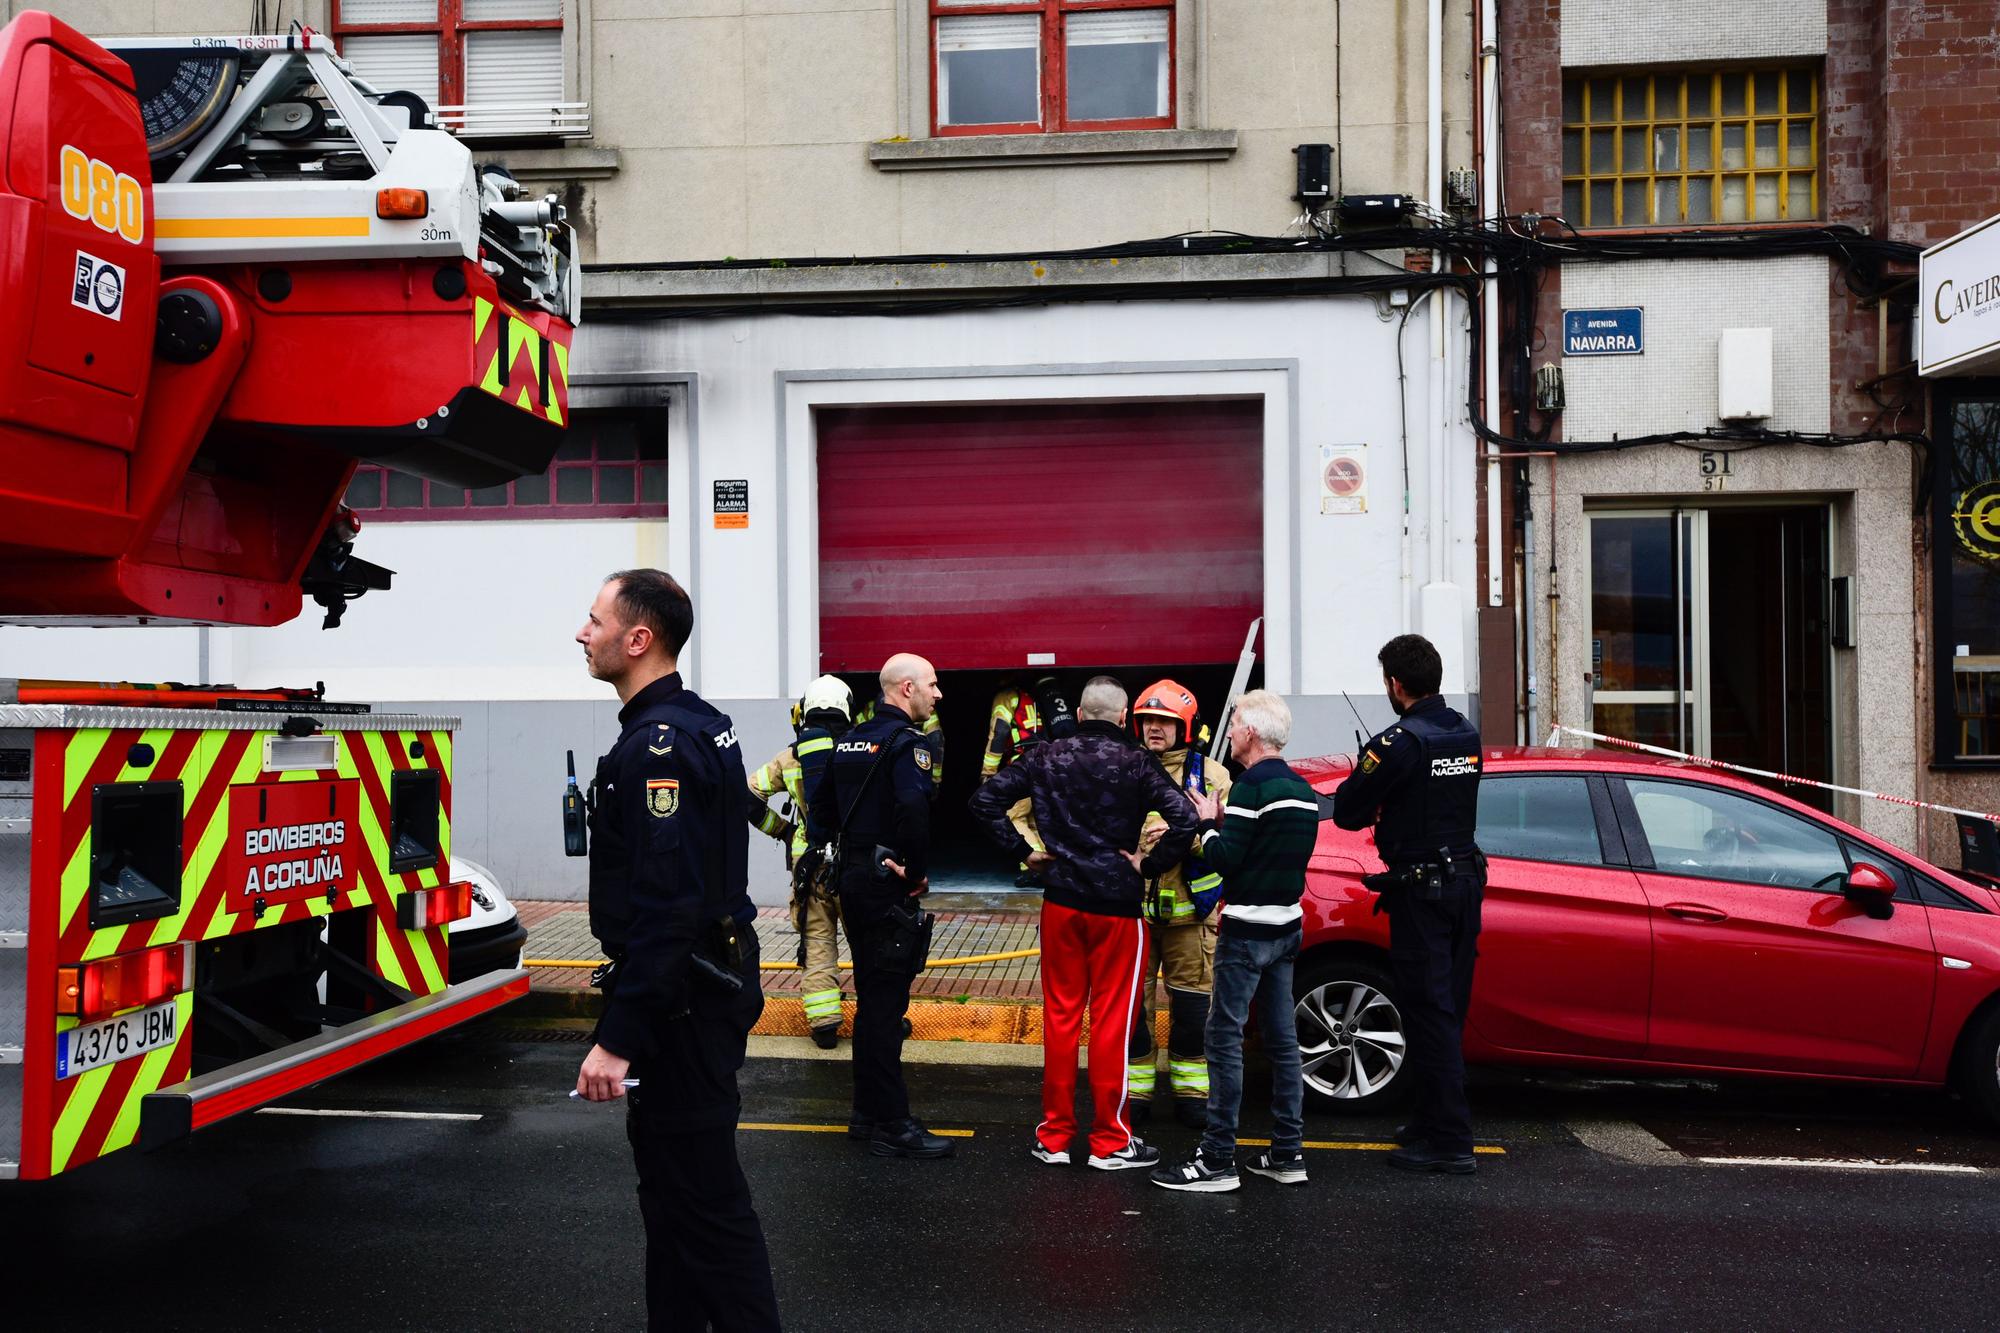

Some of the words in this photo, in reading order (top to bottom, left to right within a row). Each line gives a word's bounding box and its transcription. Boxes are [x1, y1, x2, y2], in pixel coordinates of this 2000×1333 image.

[60, 144, 144, 245] 080
[421, 228, 451, 241] 30m
[1587, 320, 1618, 328] AVENIDA
[1570, 335, 1637, 351] NAVARRA
[1702, 451, 1731, 474] 51
[1704, 476, 1724, 491] 51
[1054, 698, 1067, 712] 3
[836, 742, 872, 753] POLICIA
[1431, 756, 1470, 768] POLICIA
[1431, 765, 1478, 777] NACIONAL
[245, 821, 345, 856] BOMBEIROS
[244, 866, 261, 896] A
[263, 848, 344, 892] CORUÑA
[73, 1020, 129, 1067] 4376
[136, 1006, 174, 1048] JBM
